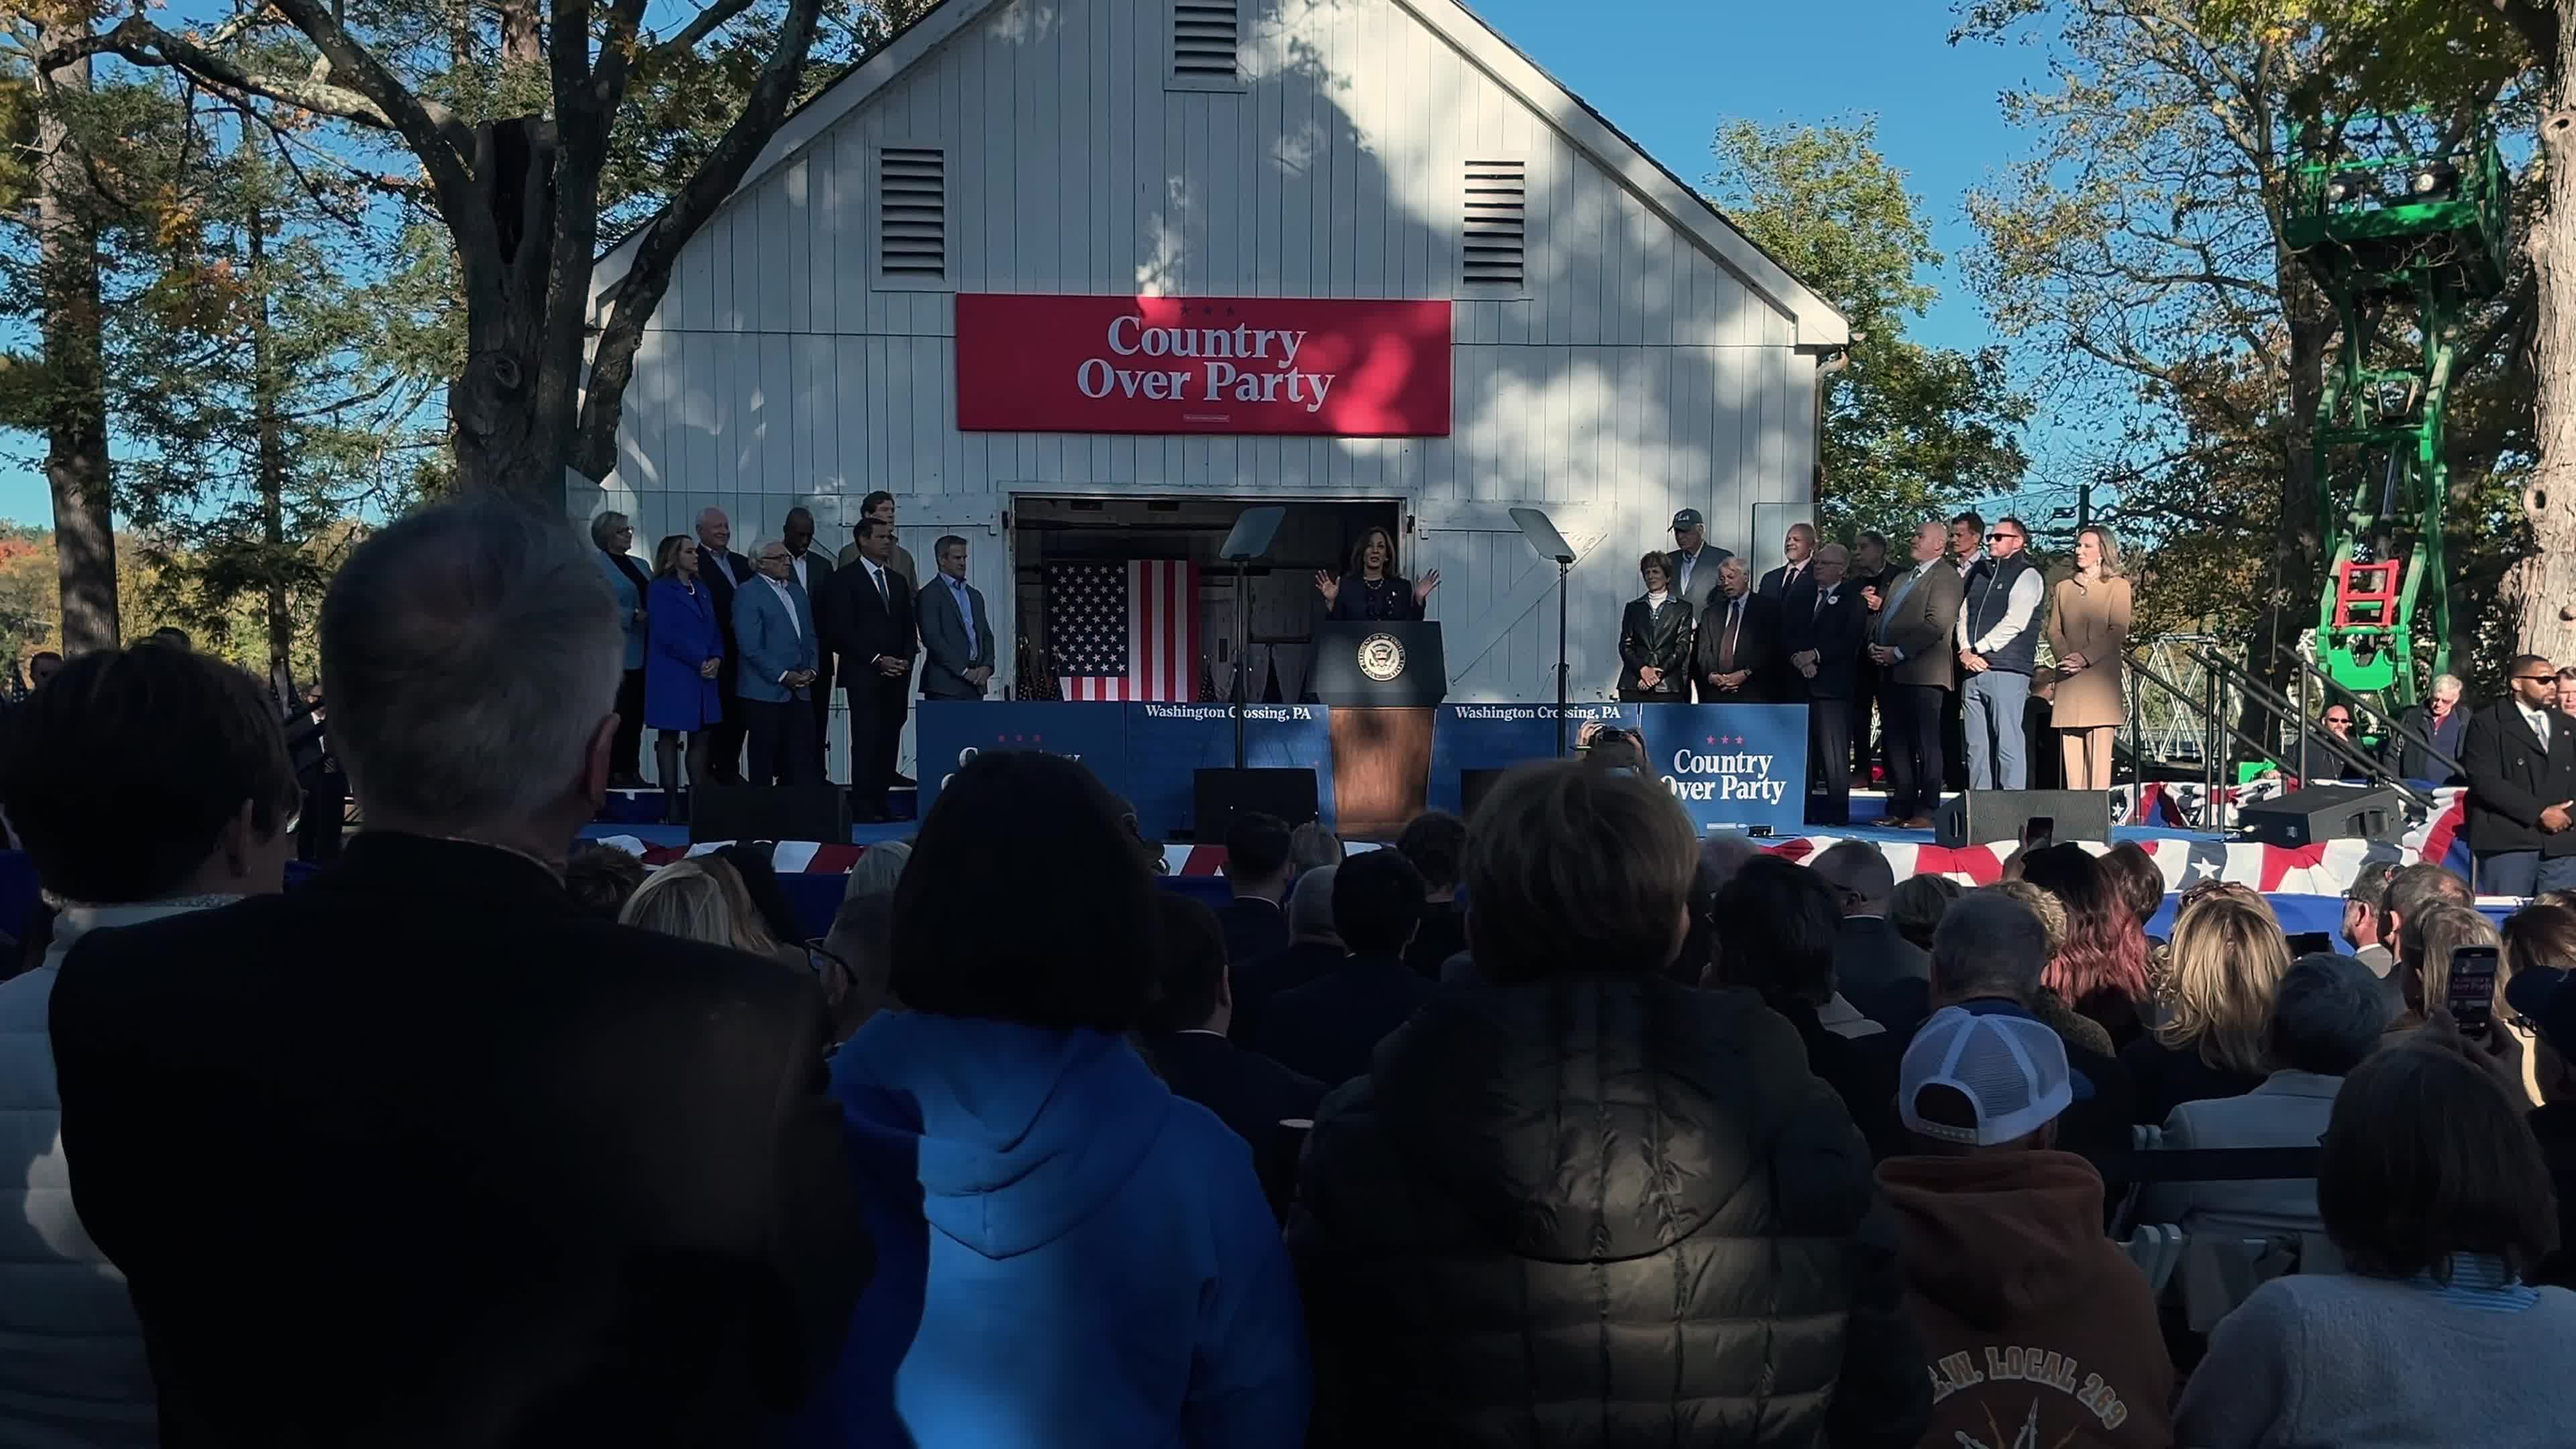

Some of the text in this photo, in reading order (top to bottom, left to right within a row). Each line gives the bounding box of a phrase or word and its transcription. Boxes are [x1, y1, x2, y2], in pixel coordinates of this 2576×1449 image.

[1108, 315, 1307, 369] Country
[1077, 358, 1336, 413] Over Party
[1145, 704, 1312, 722] Washington Cossing, PA
[1454, 706, 1621, 721] Washington Crosing, PA
[1674, 749, 1773, 780] Country
[1720, 775, 1787, 805] Party
[1985, 1346, 2078, 1395] LOCAL
[2077, 1372, 2128, 1431] 269
